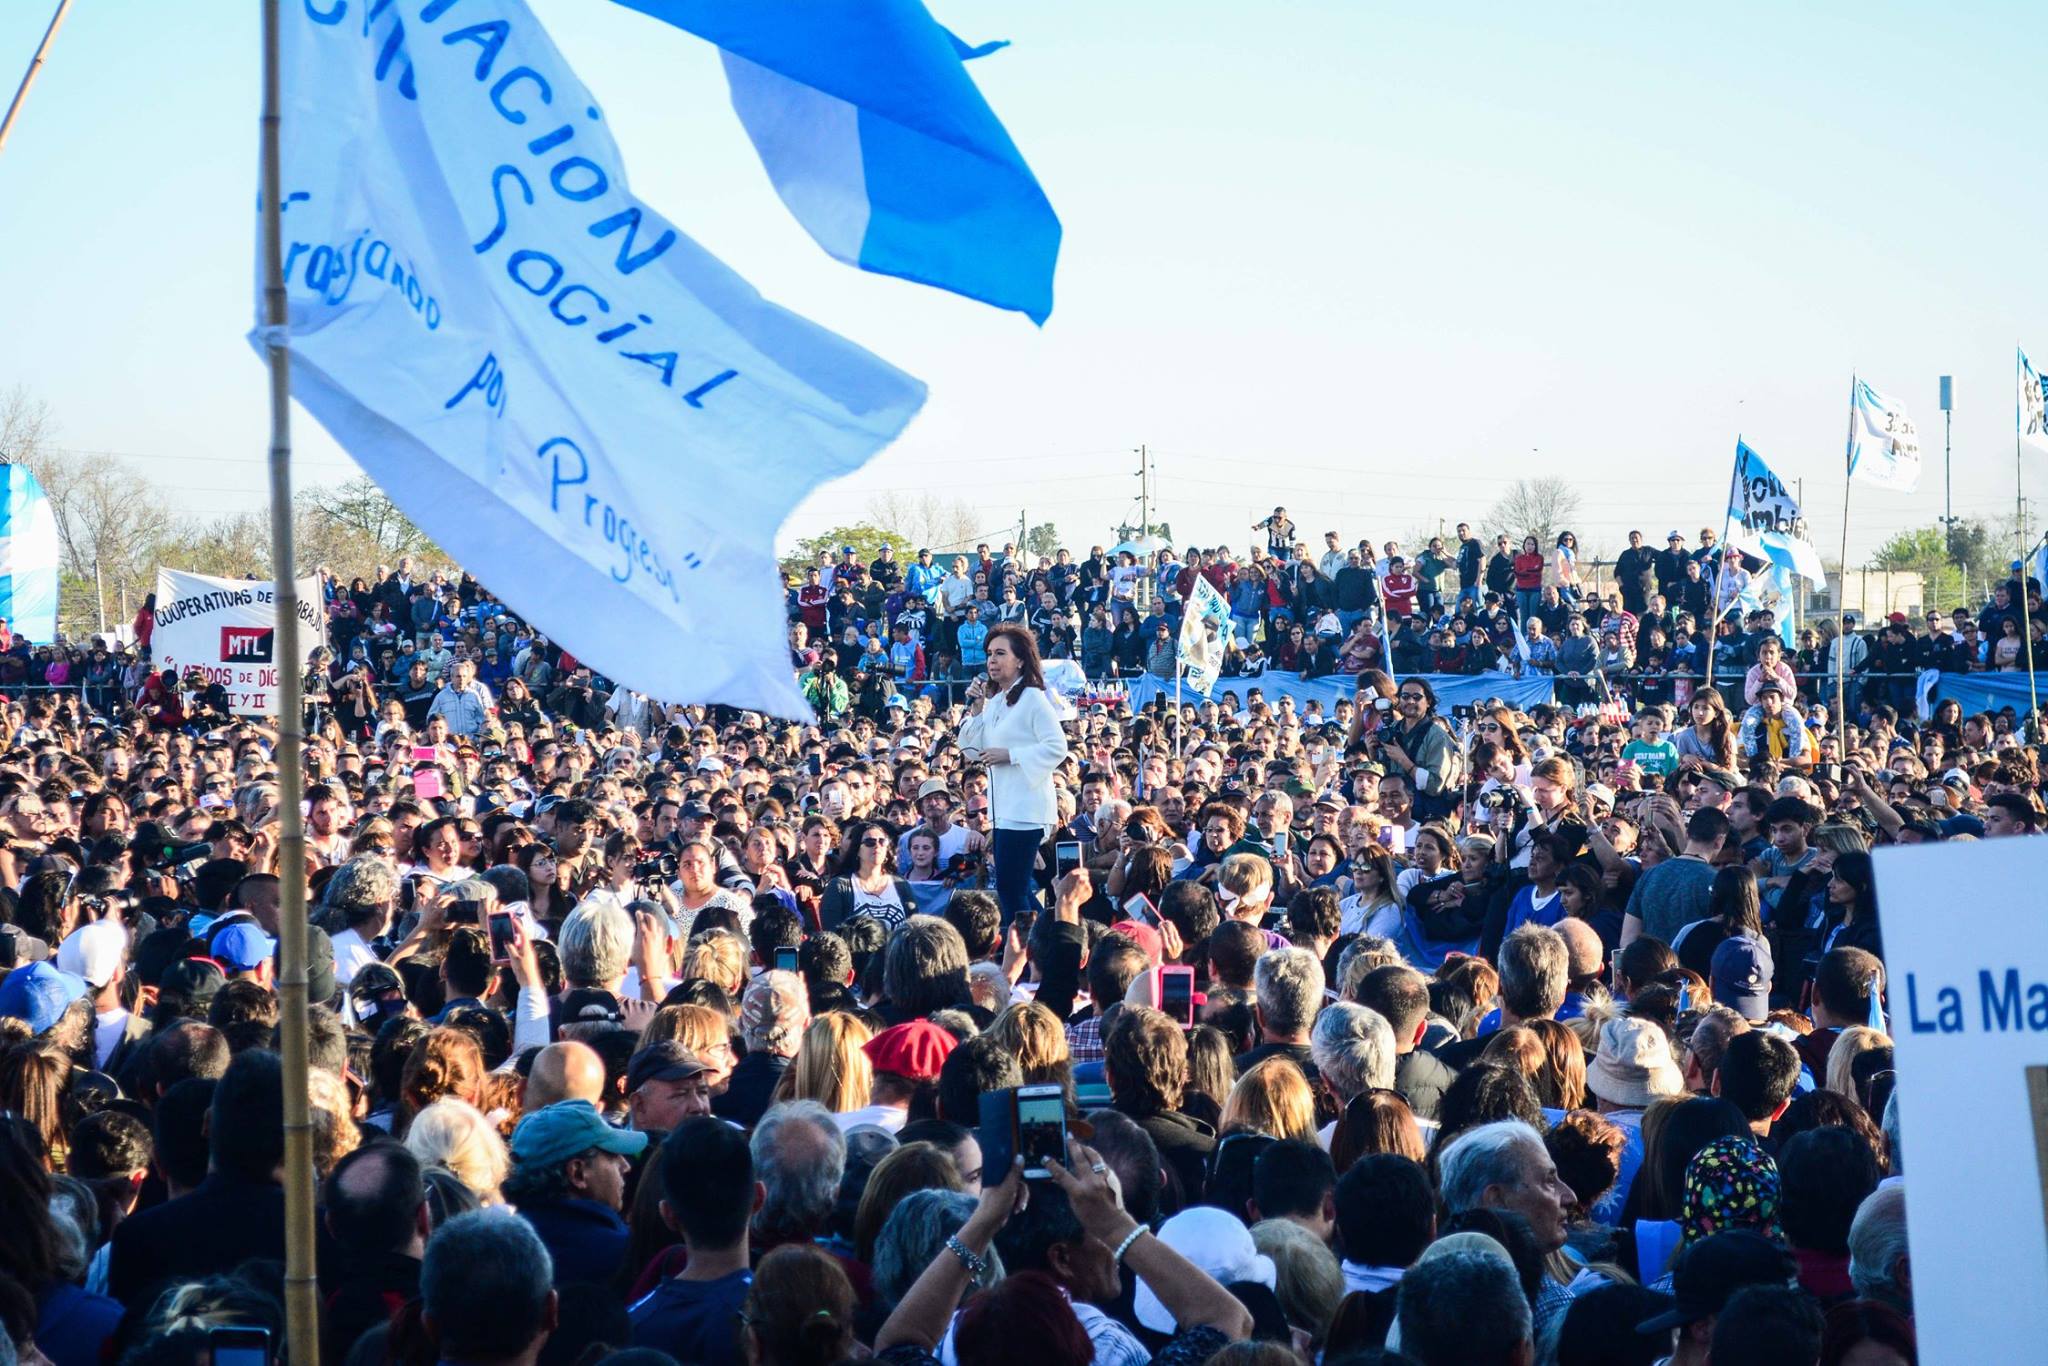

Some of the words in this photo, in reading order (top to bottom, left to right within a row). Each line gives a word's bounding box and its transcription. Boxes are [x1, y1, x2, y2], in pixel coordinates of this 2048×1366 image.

[154, 589, 252, 628] COOPERATIVAS
[257, 591, 273, 604] DE
[297, 600, 321, 632] ABAJO
[228, 634, 265, 656] MTL
[239, 672, 253, 683] DE
[259, 665, 280, 687] DIG
[227, 693, 236, 707] I
[241, 693, 250, 706] Y
[252, 693, 266, 708] II
[1907, 972, 1965, 1034] La
